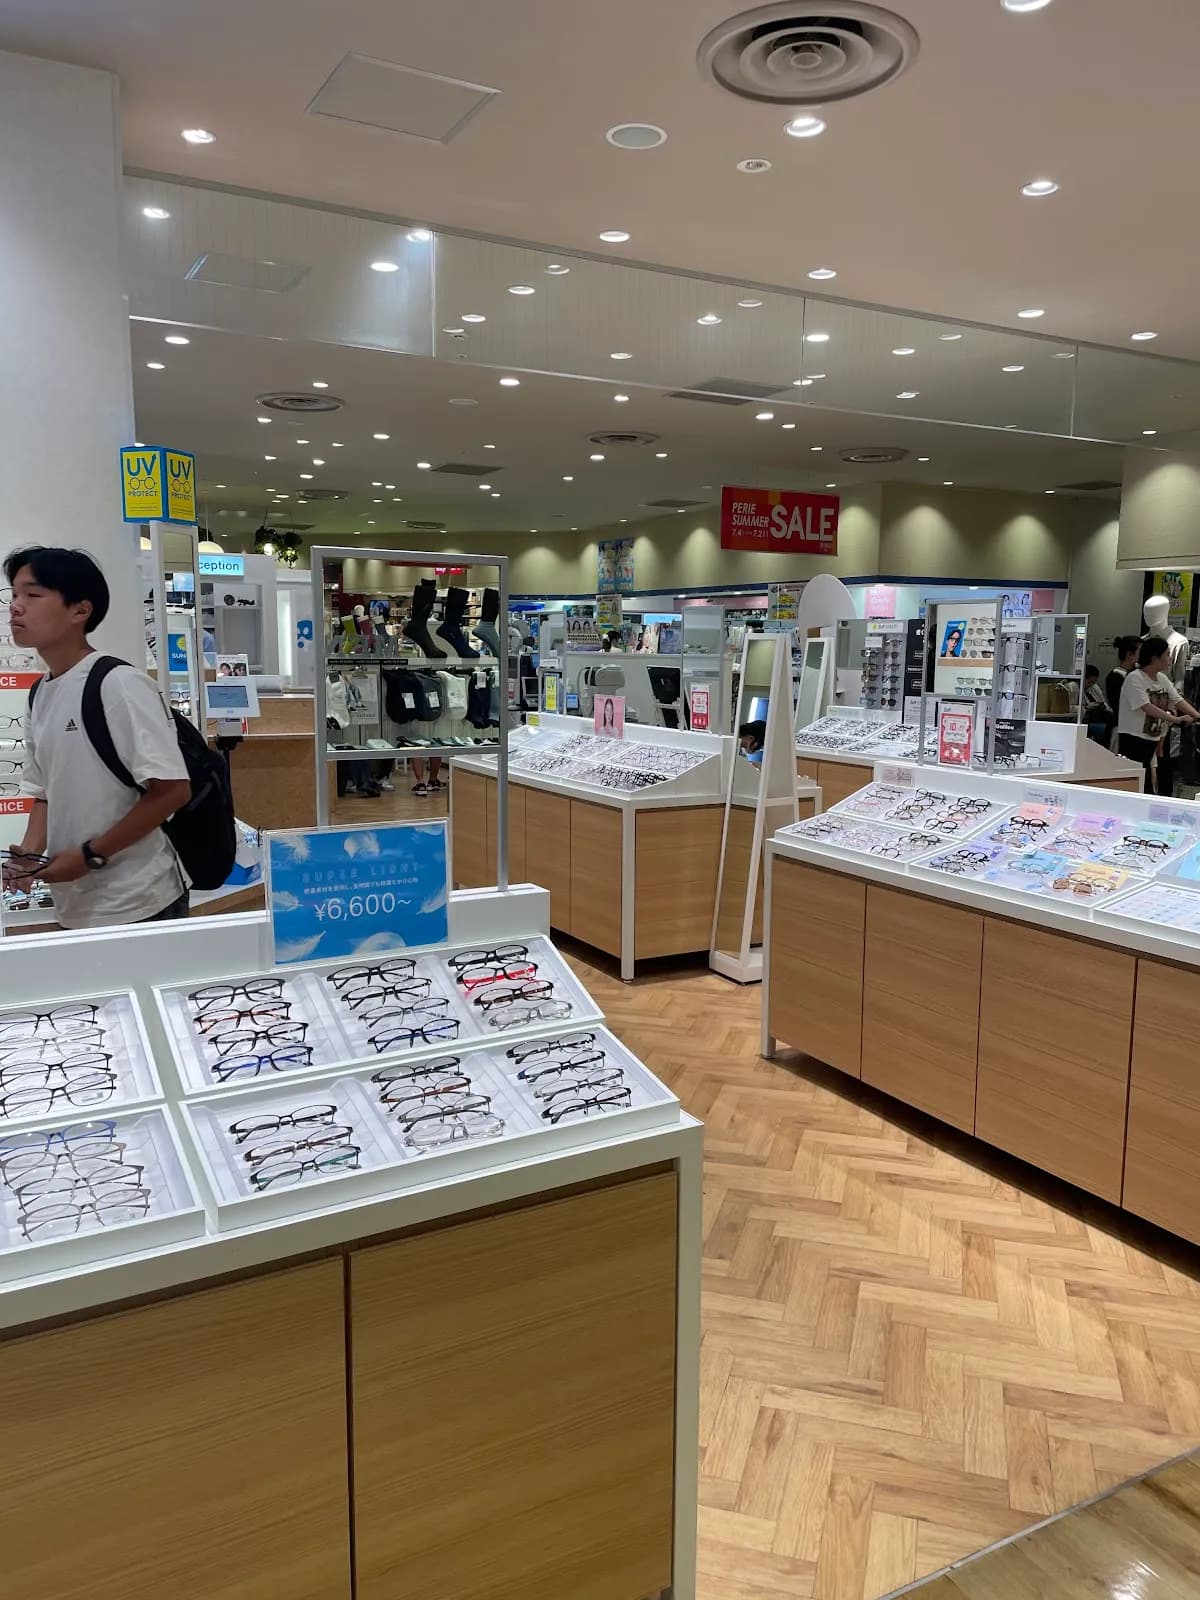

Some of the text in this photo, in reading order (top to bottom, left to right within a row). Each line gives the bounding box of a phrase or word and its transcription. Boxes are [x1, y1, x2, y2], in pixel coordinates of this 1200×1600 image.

[127, 454, 156, 476] UV
[170, 459, 191, 480] UV
[732, 502, 756, 514] PERIE
[732, 514, 769, 527] SUMMER
[770, 505, 834, 541] SALE
[199, 560, 240, 572] ception
